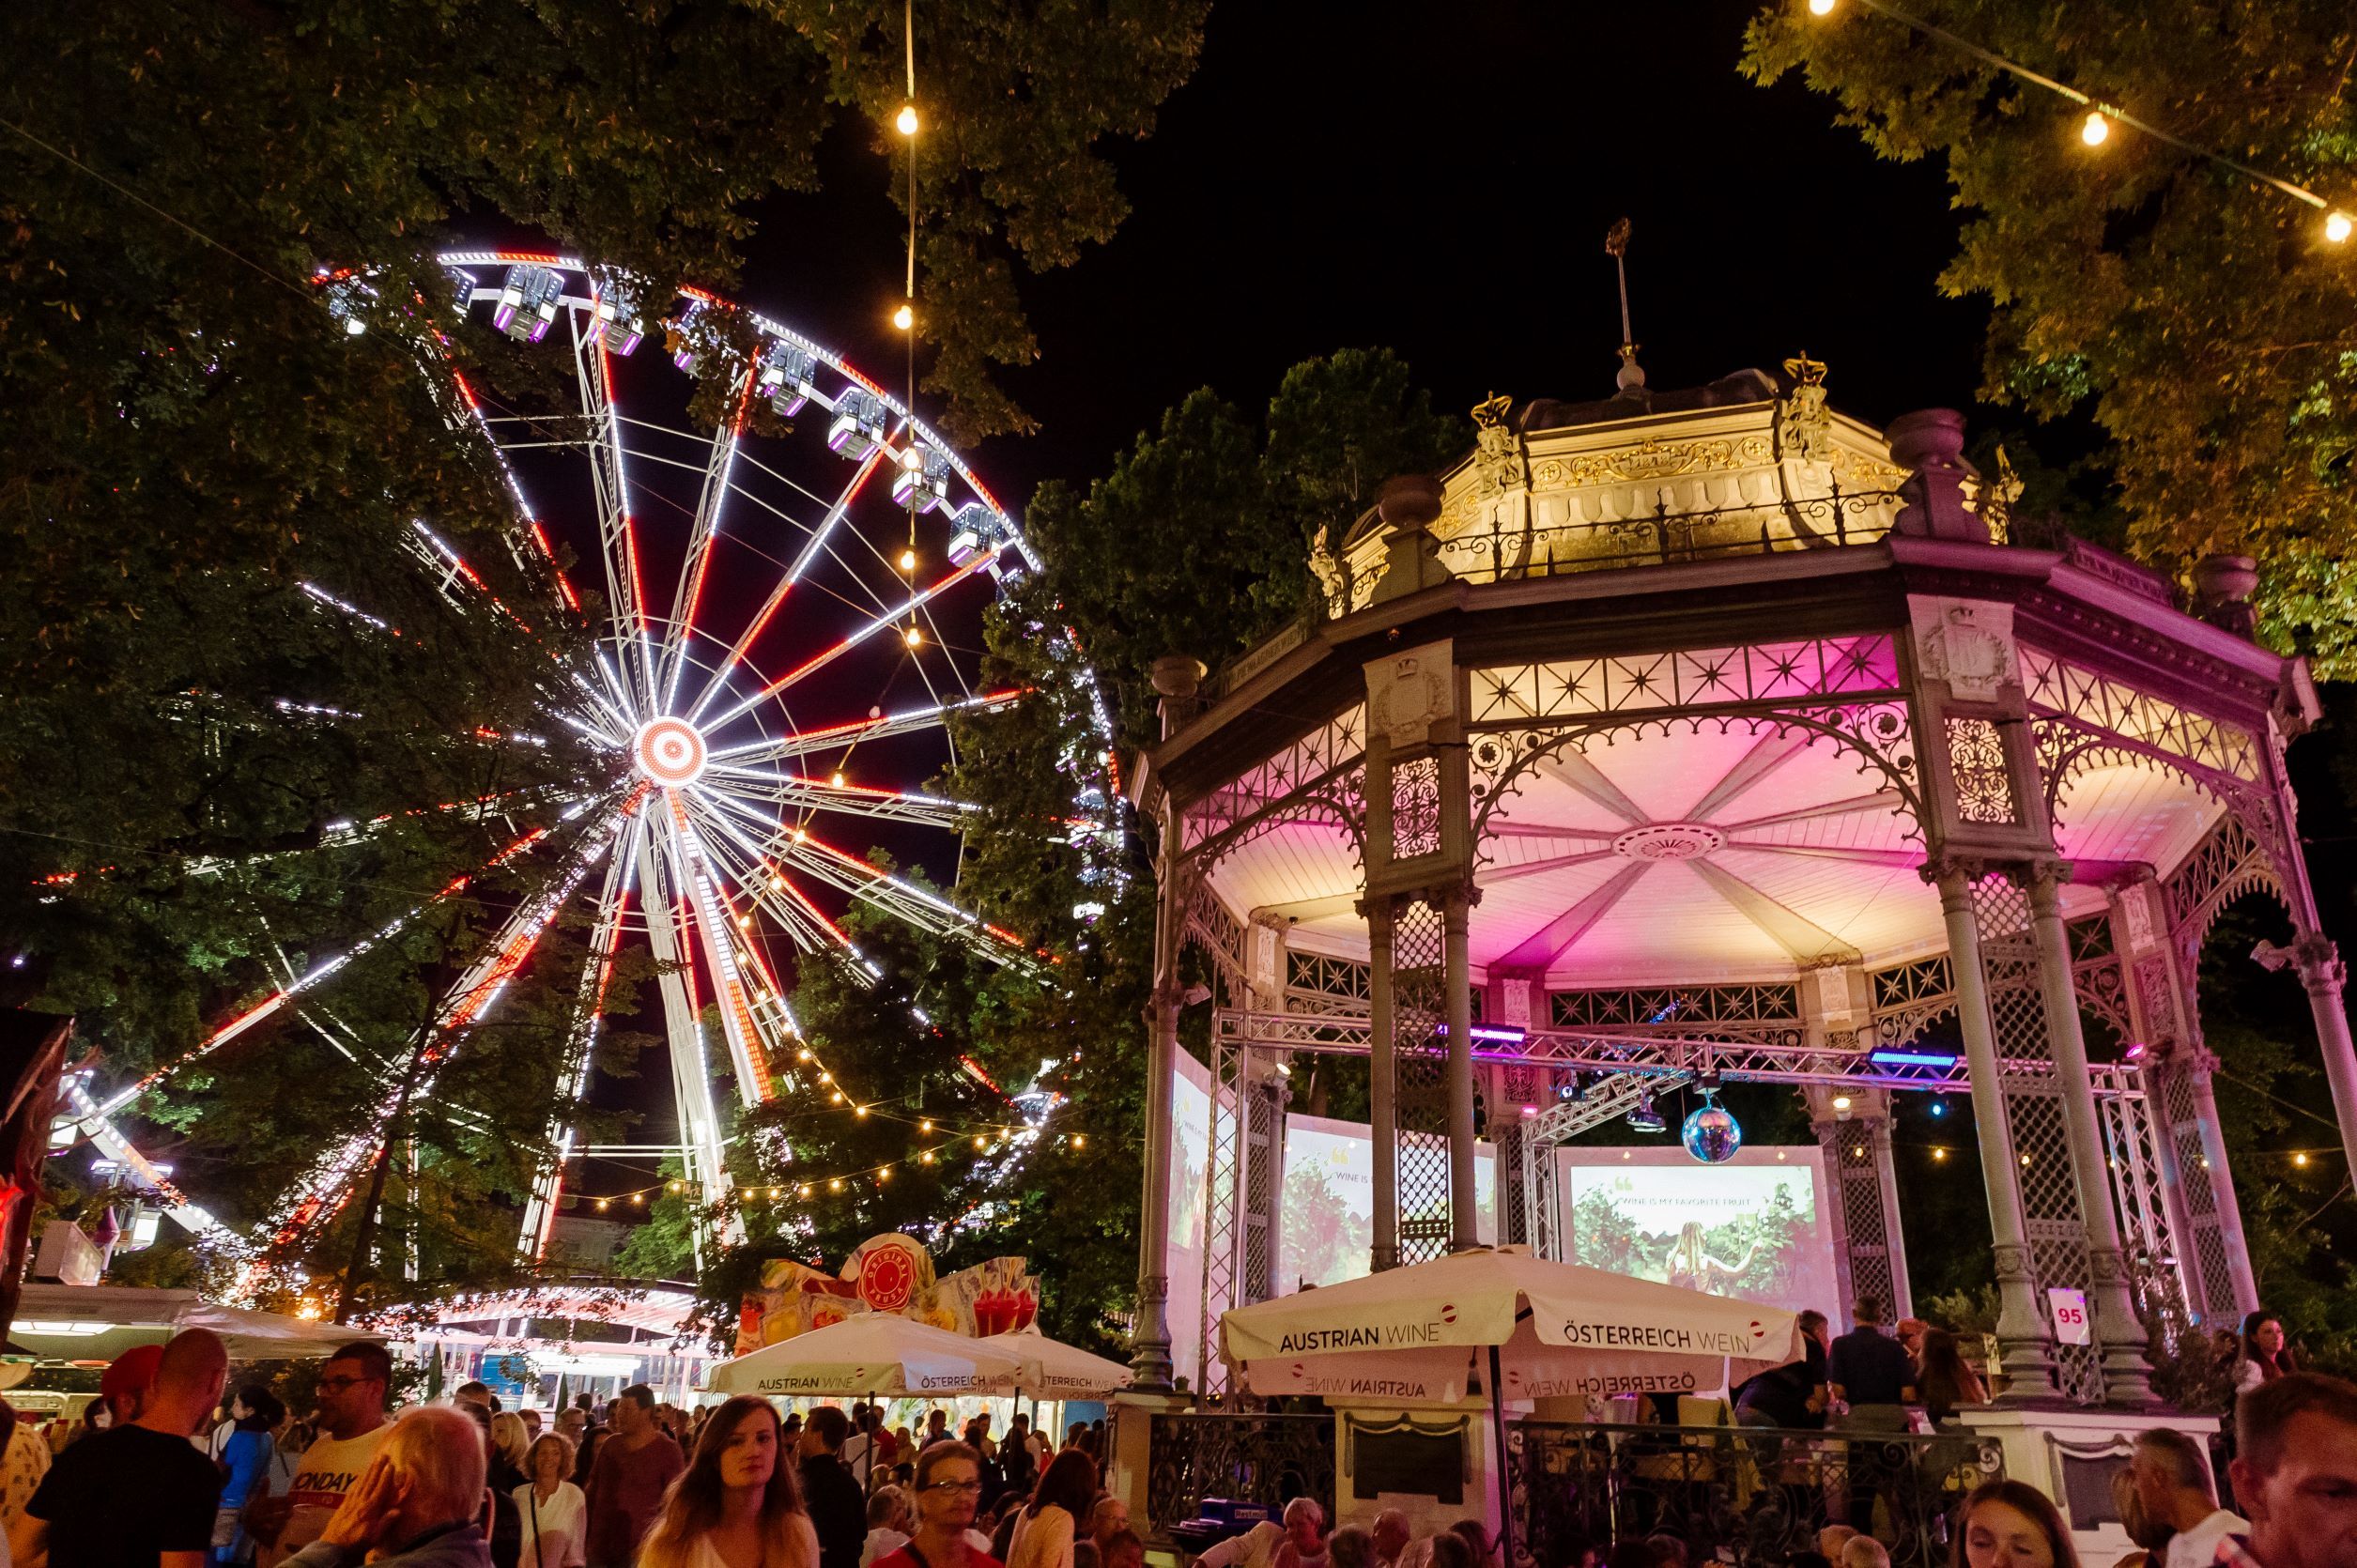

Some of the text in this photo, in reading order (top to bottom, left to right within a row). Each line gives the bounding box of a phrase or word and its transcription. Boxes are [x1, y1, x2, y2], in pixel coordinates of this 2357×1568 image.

[1336, 1171, 1368, 1184] WINE IS
[1623, 1197, 1750, 1207] WINE IS MY FAVORITE FRUIT
[868, 1253, 908, 1279] ORIGINAL
[2058, 1308, 2082, 1324] 95
[1280, 1322, 1440, 1353] AUSTRIAN WINE
[1564, 1319, 1749, 1353] ÖSTERREICH WEIN
[758, 1376, 854, 1391] AUSTRIAN WINE
[921, 1375, 985, 1389] ÖSTERREICH
[1043, 1376, 1092, 1388] TERREICH
[291, 1471, 358, 1491] ONDAY
